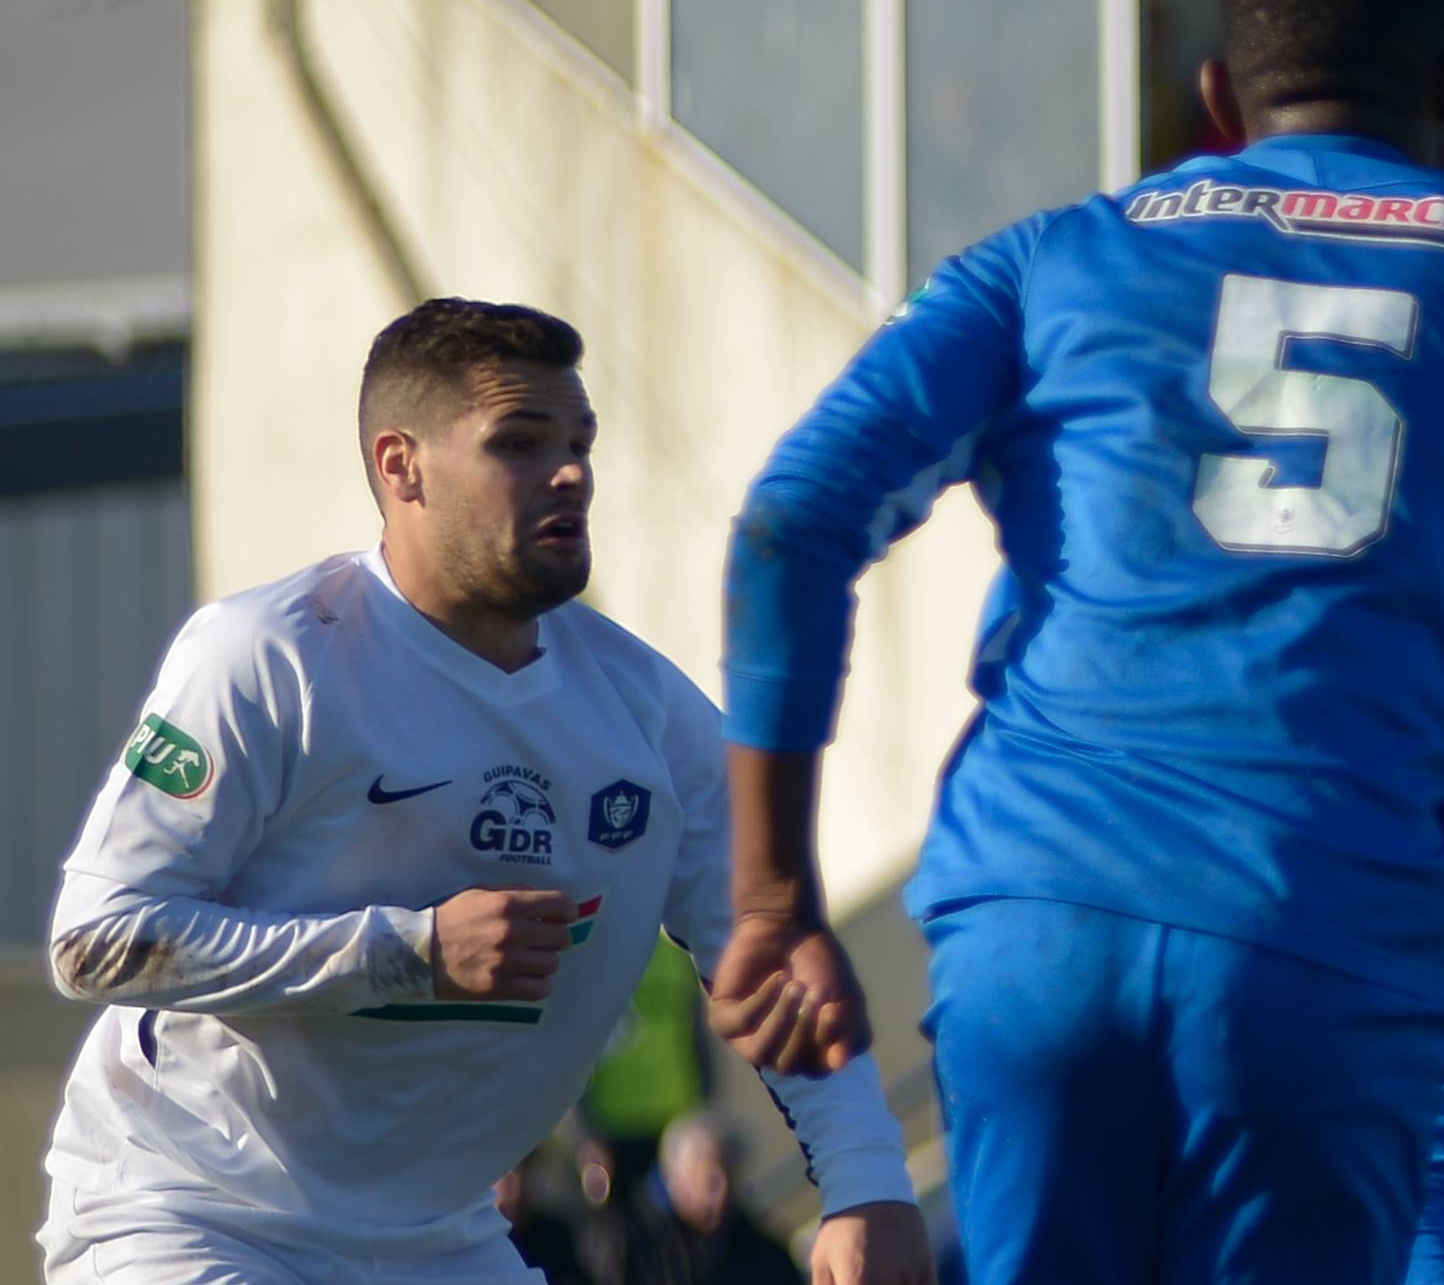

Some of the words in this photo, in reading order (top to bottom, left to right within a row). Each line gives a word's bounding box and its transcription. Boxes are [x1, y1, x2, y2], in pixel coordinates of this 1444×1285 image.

[1193, 273, 1418, 557] 5
[483, 765, 552, 792] GUIPAVAS
[470, 810, 552, 854] GDR
[499, 853, 552, 866] FOOTBALL
